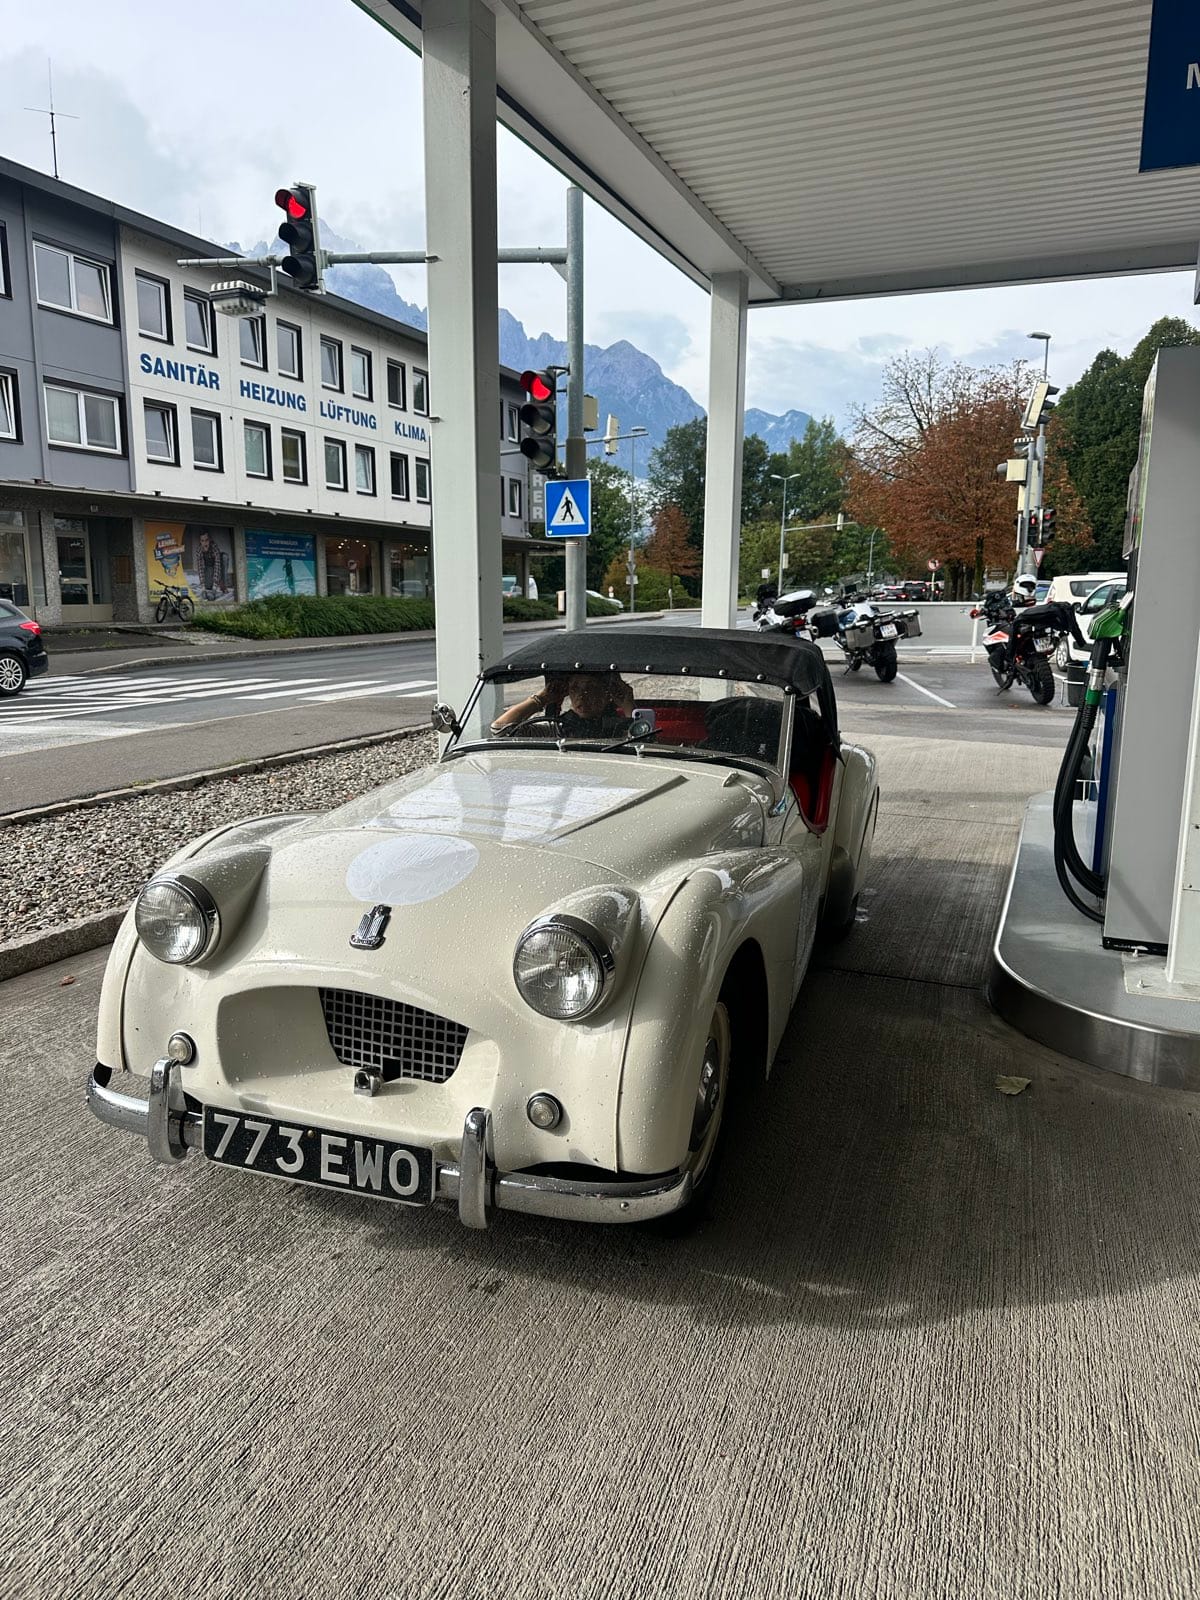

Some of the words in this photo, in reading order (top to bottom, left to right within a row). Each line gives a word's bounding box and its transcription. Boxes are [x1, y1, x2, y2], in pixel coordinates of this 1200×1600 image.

[140, 353, 220, 390] SANITÄR
[240, 380, 306, 411] HEIZUNG
[320, 400, 376, 429] LÜFTUNG
[395, 421, 426, 442] KLIMA
[214, 1113, 305, 1174] 773
[321, 1134, 420, 1196] EWO
